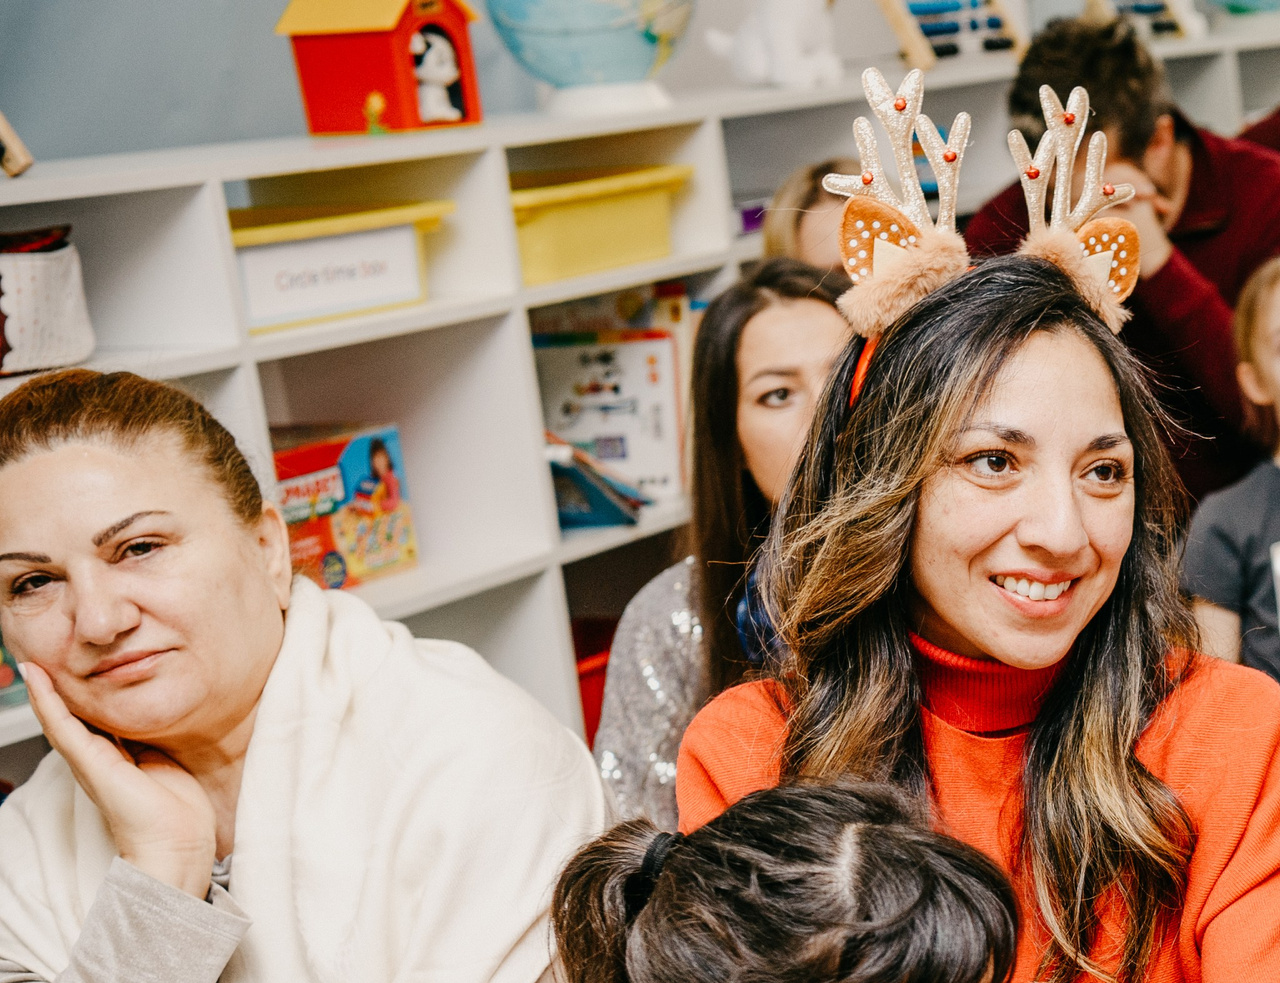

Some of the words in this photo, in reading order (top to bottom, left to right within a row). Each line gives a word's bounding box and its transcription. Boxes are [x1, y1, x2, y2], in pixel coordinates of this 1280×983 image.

[275, 267, 320, 291] Circle
[322, 262, 357, 284] time
[359, 258, 389, 279] box
